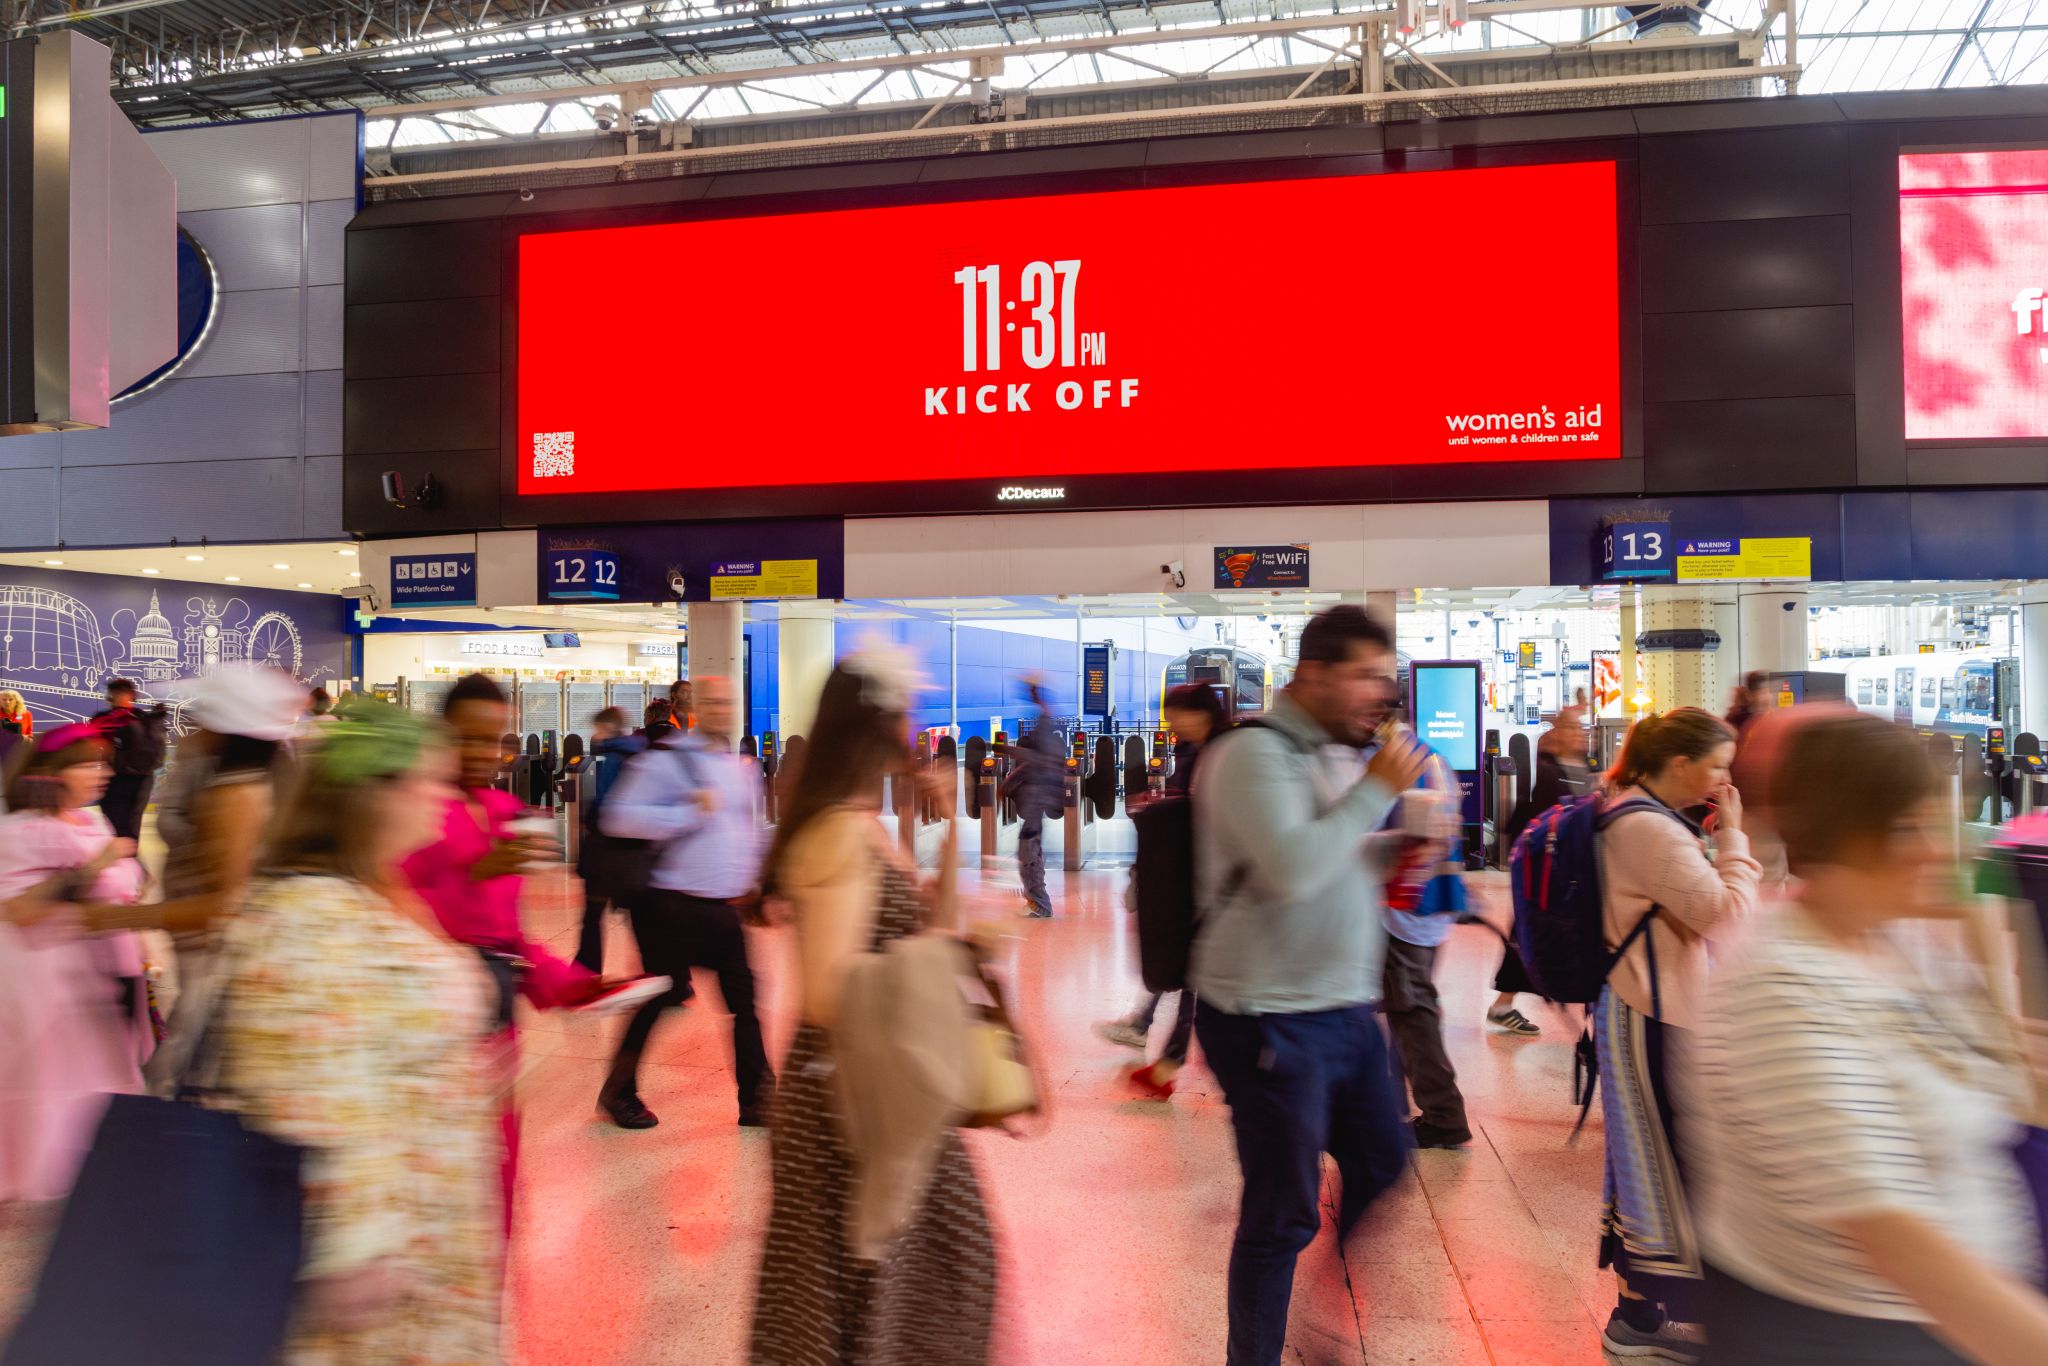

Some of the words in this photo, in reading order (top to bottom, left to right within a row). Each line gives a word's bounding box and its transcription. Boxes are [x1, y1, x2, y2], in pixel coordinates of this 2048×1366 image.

[954, 259, 1081, 371] 11:37
[1080, 332, 1106, 366] PM
[925, 384, 1031, 416] KICK
[1055, 379, 1139, 410] OFF
[1446, 405, 1555, 431] women's
[1565, 404, 1601, 428] aid
[1449, 436, 1469, 445] until
[1472, 435, 1507, 444] women
[1510, 434, 1518, 443] &
[1521, 433, 1559, 443] children
[1562, 434, 1577, 442] are
[1580, 432, 1599, 441] safe
[997, 487, 1065, 500] JCDecaux
[1622, 532, 1662, 561] 13
[1276, 553, 1307, 565] WiFi
[555, 558, 586, 583] 12
[595, 559, 617, 585] 12
[396, 586, 413, 594] Wide
[413, 585, 440, 593] Platform
[440, 584, 456, 592] Gate
[468, 642, 500, 654] FOOD
[503, 644, 509, 655] &
[513, 645, 544, 656] DRINK
[1504, 654, 1514, 662] 13
[1949, 711, 1965, 723] South
